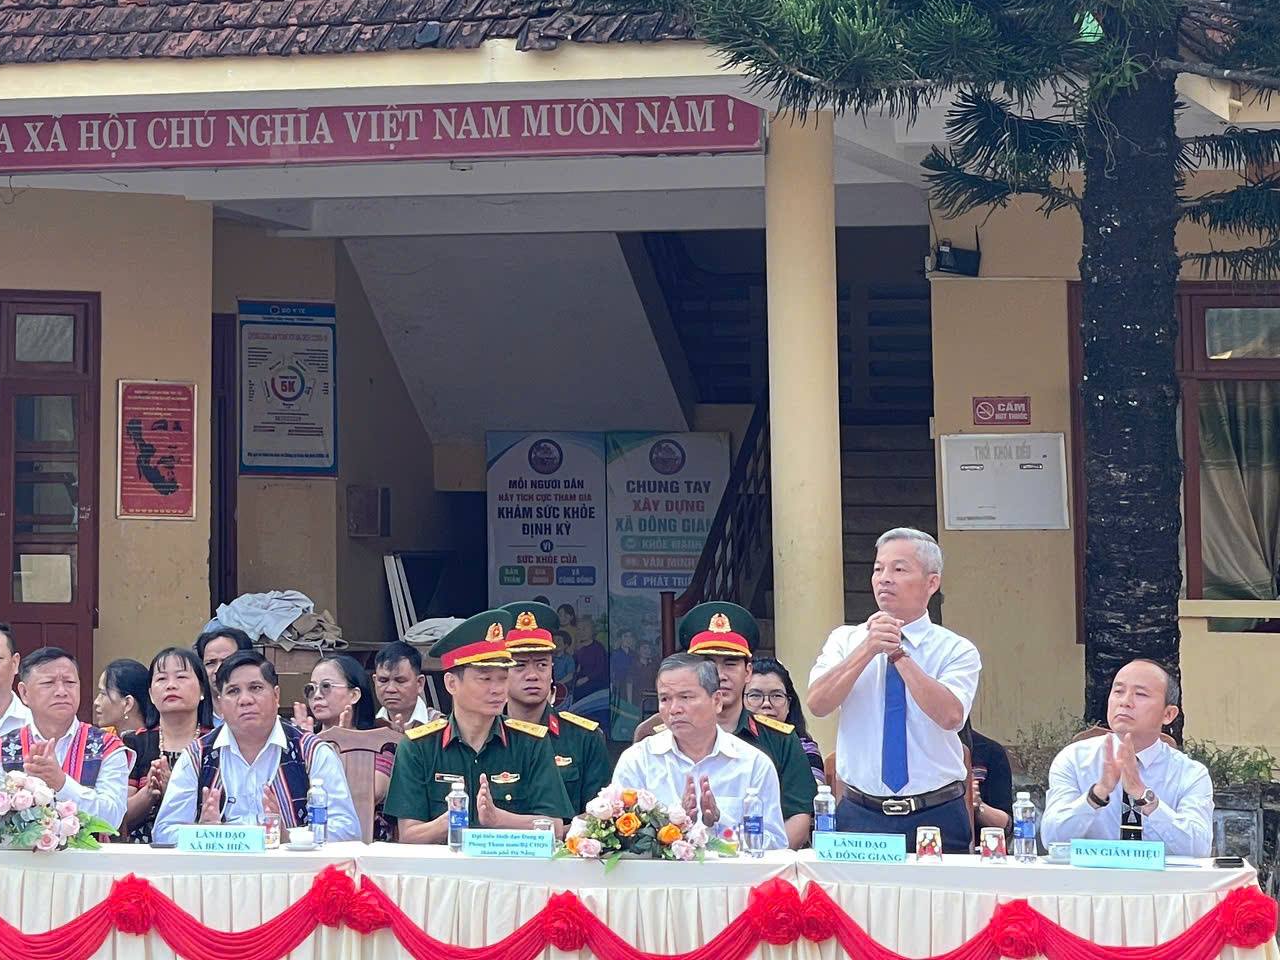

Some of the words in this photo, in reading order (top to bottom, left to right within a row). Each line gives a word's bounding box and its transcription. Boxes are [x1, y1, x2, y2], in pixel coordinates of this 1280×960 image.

[24, 112, 67, 153] XÃ
[78, 113, 136, 158] HỘI
[226, 106, 334, 146] NGHĨA
[344, 104, 423, 150] VIỆT
[433, 106, 510, 140] NAM
[521, 98, 624, 136] MUÔN
[626, 480, 679, 493] CHUNG
[684, 480, 711, 493] TAY
[522, 523, 552, 538] ĐỊNH
